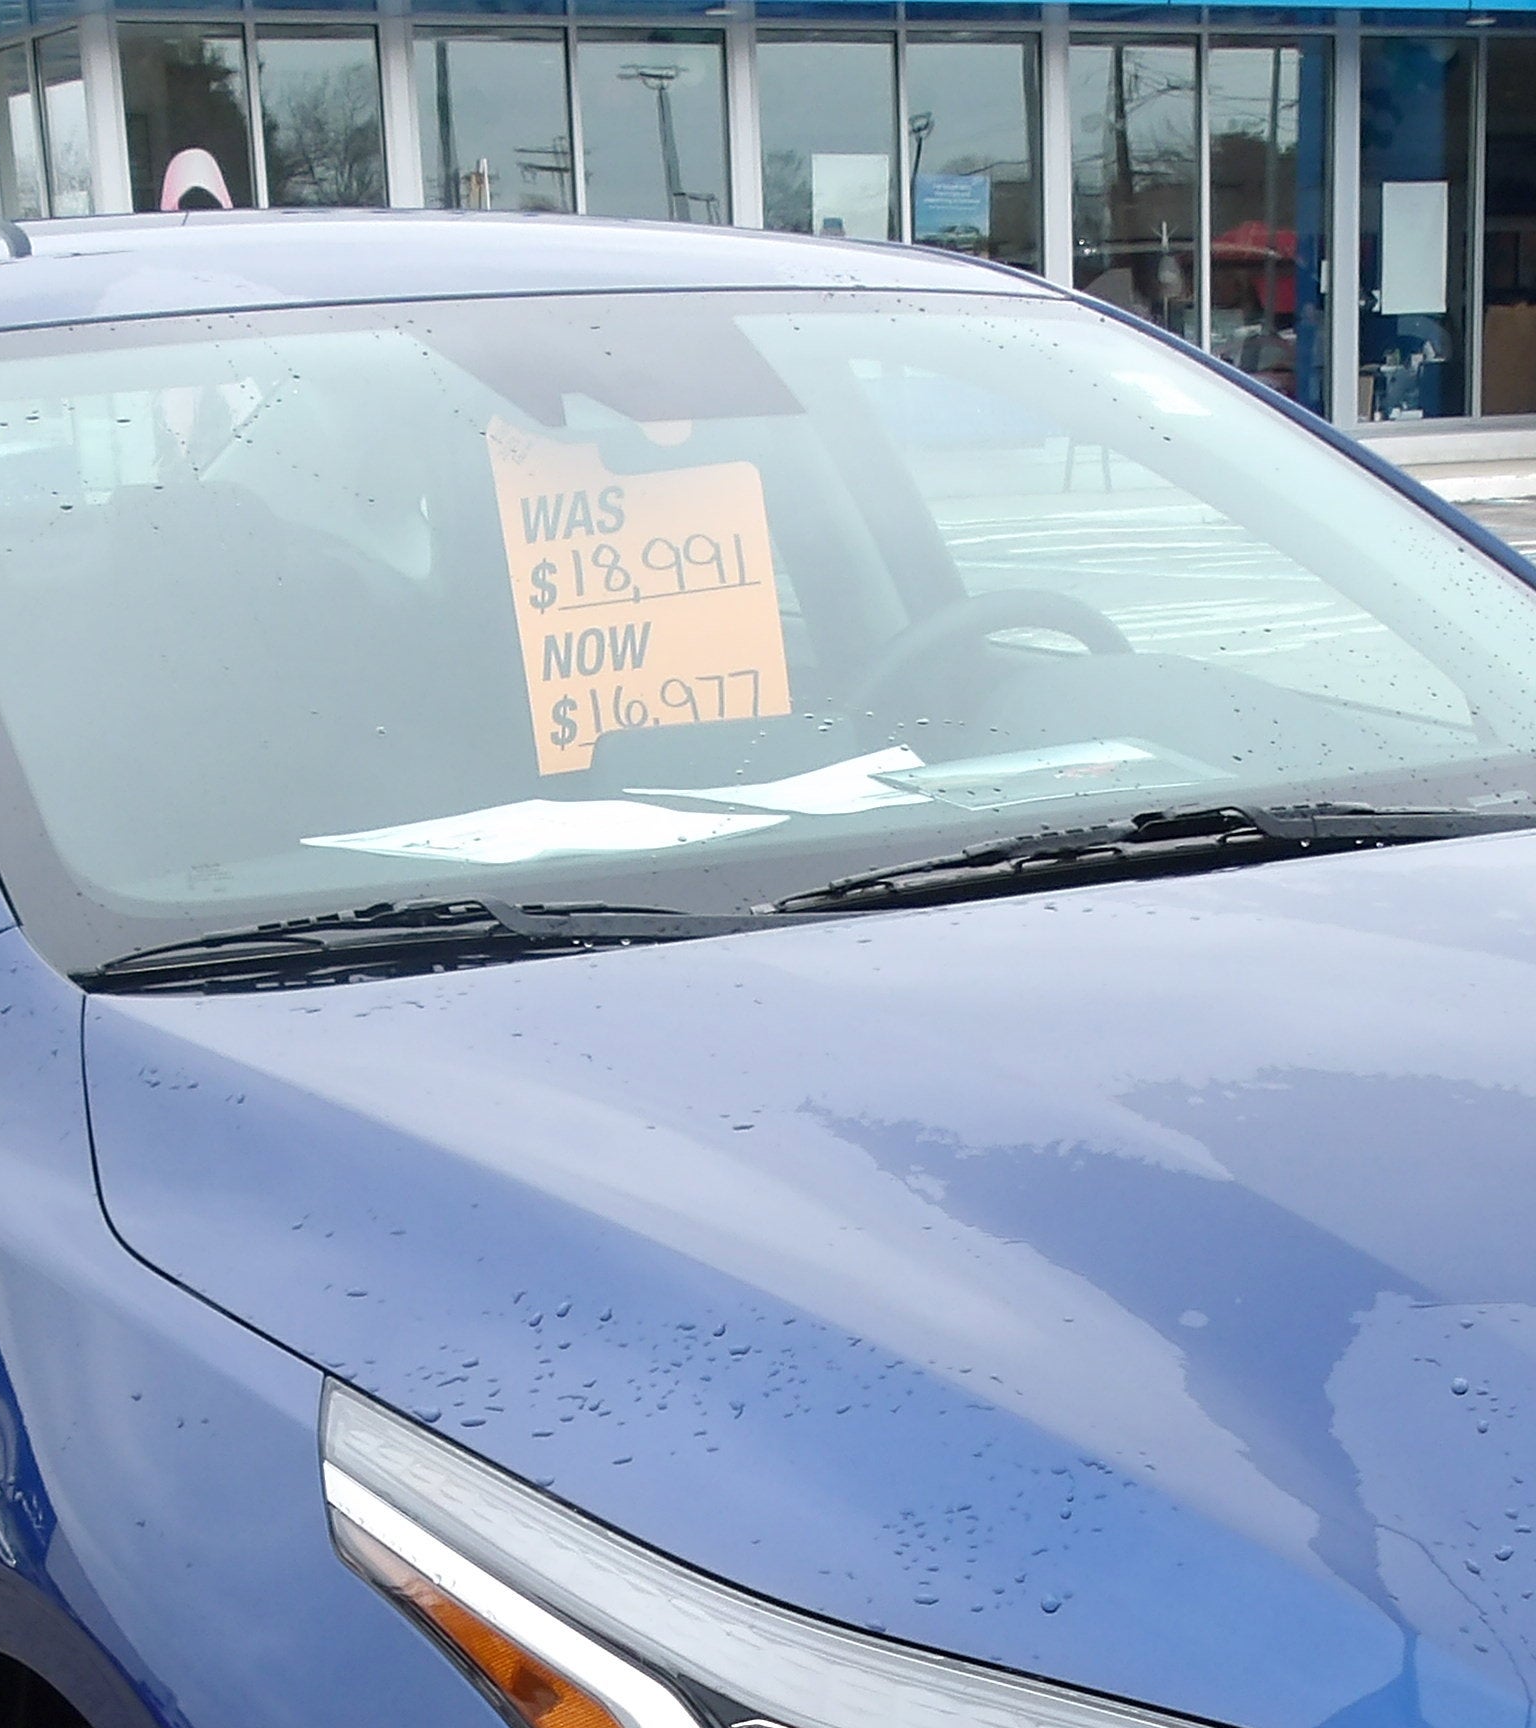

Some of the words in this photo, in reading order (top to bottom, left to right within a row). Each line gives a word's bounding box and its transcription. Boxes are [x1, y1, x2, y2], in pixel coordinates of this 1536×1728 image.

[520, 485, 626, 544] WAS
[528, 533, 747, 615] $18,991
[542, 620, 652, 682] NOW
